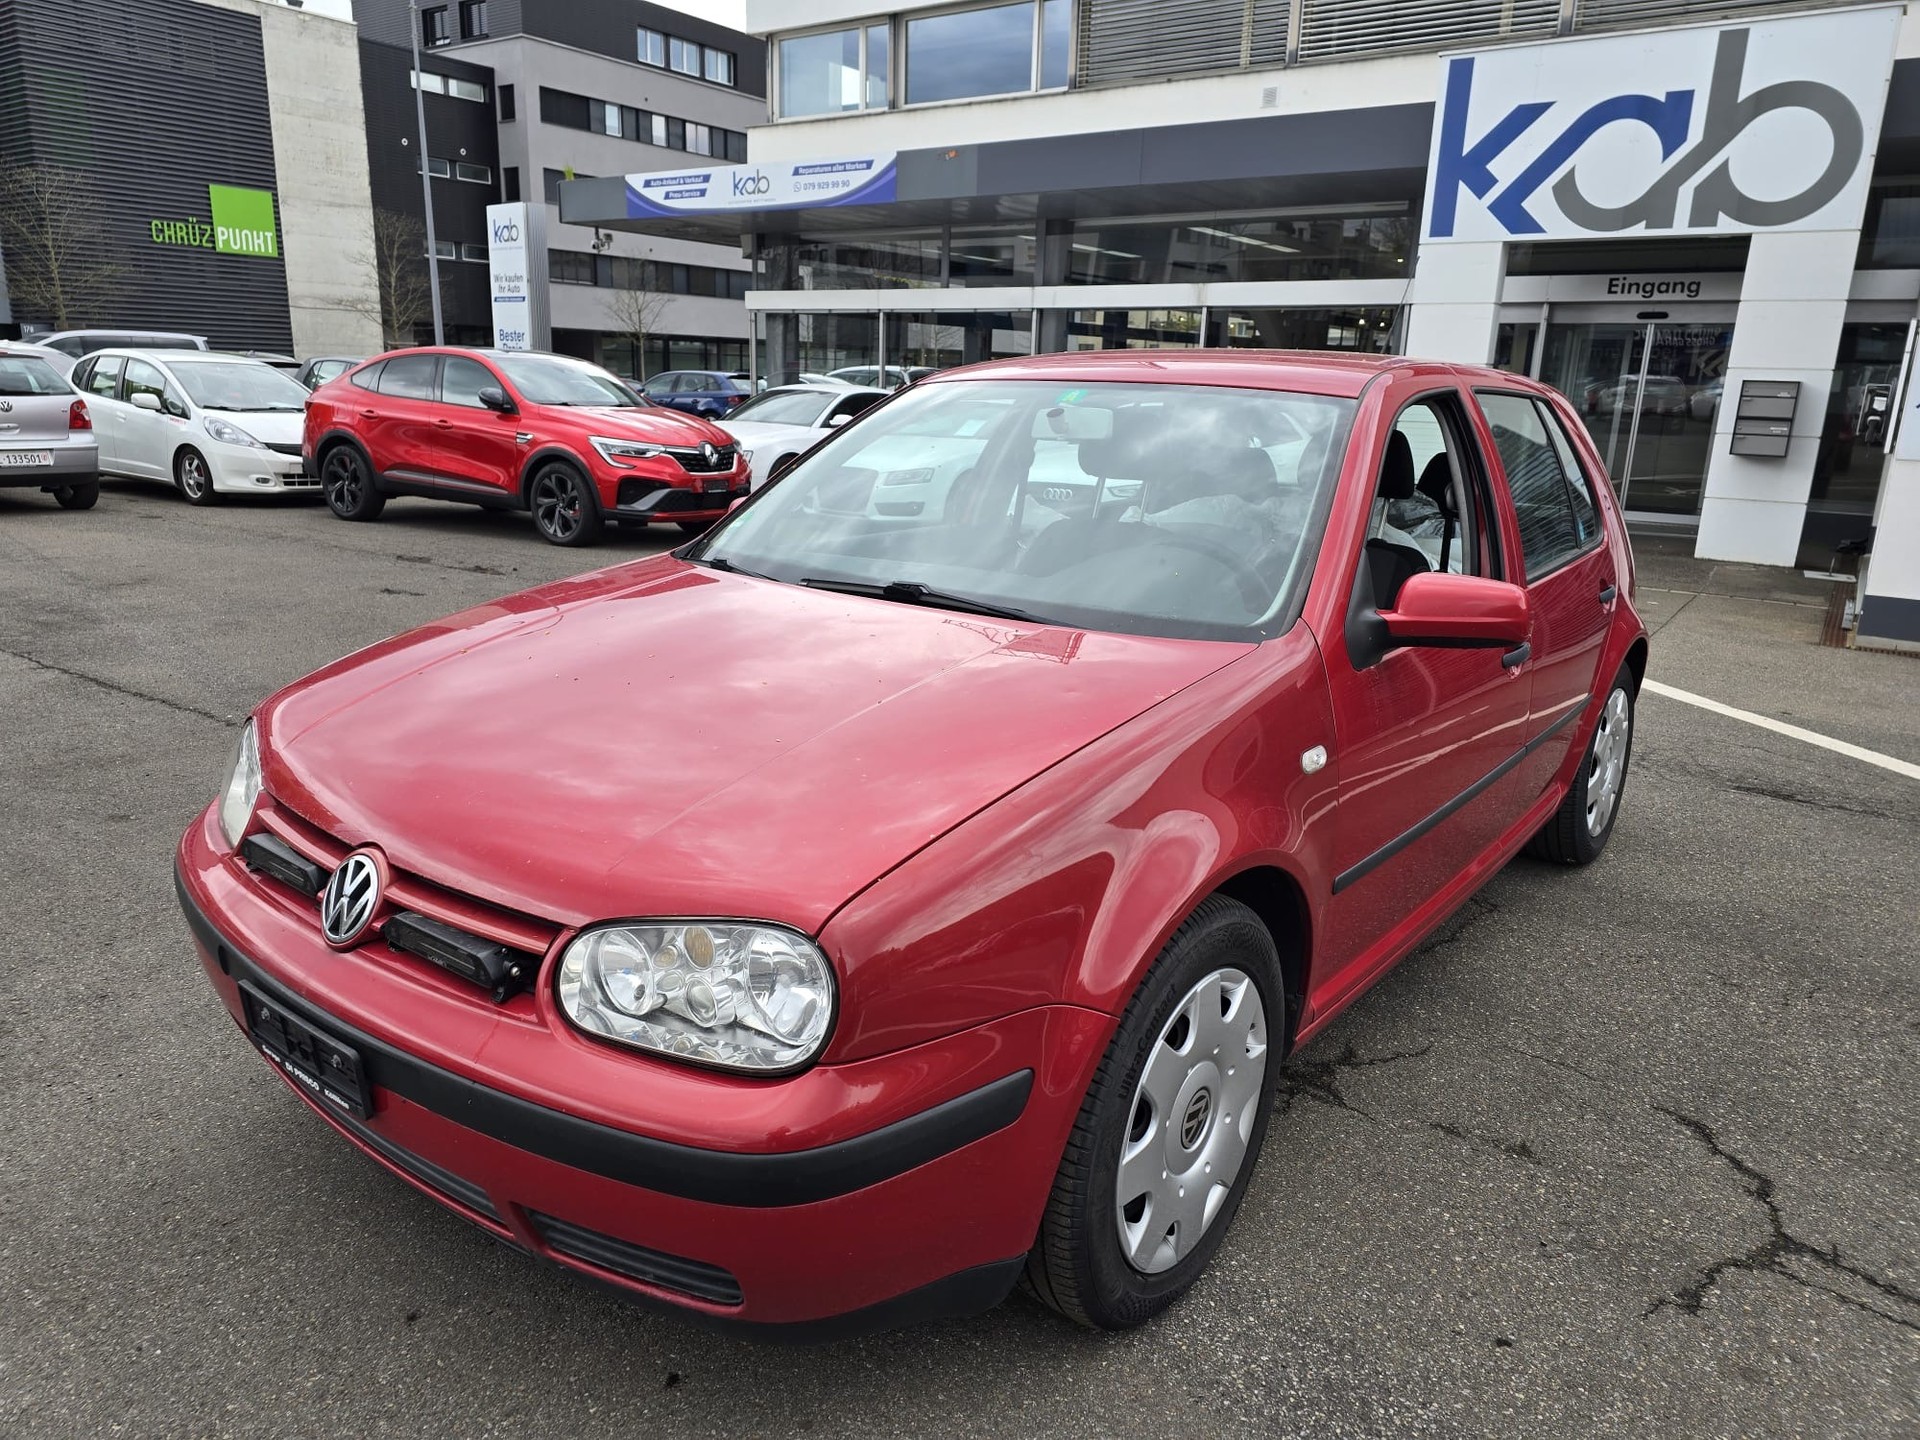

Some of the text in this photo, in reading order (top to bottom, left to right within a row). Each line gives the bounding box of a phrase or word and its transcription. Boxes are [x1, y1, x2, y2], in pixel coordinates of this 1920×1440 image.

[1429, 28, 1864, 238] kab
[798, 166, 831, 175] Reparaturen
[846, 162, 867, 170] Marken
[733, 168, 769, 196] kab
[803, 179, 850, 190] 079 929 99 90
[151, 217, 273, 253] CHRÜZ PUNKT
[494, 218, 519, 243] kab
[494, 273, 524, 283] Wir kaufen
[498, 284, 520, 293] Ihr Auto
[1607, 276, 1701, 298] Eingang
[499, 329, 525, 343] Bester
[322, 854, 379, 944] VW
[1118, 983, 1177, 1099] UltraContact
